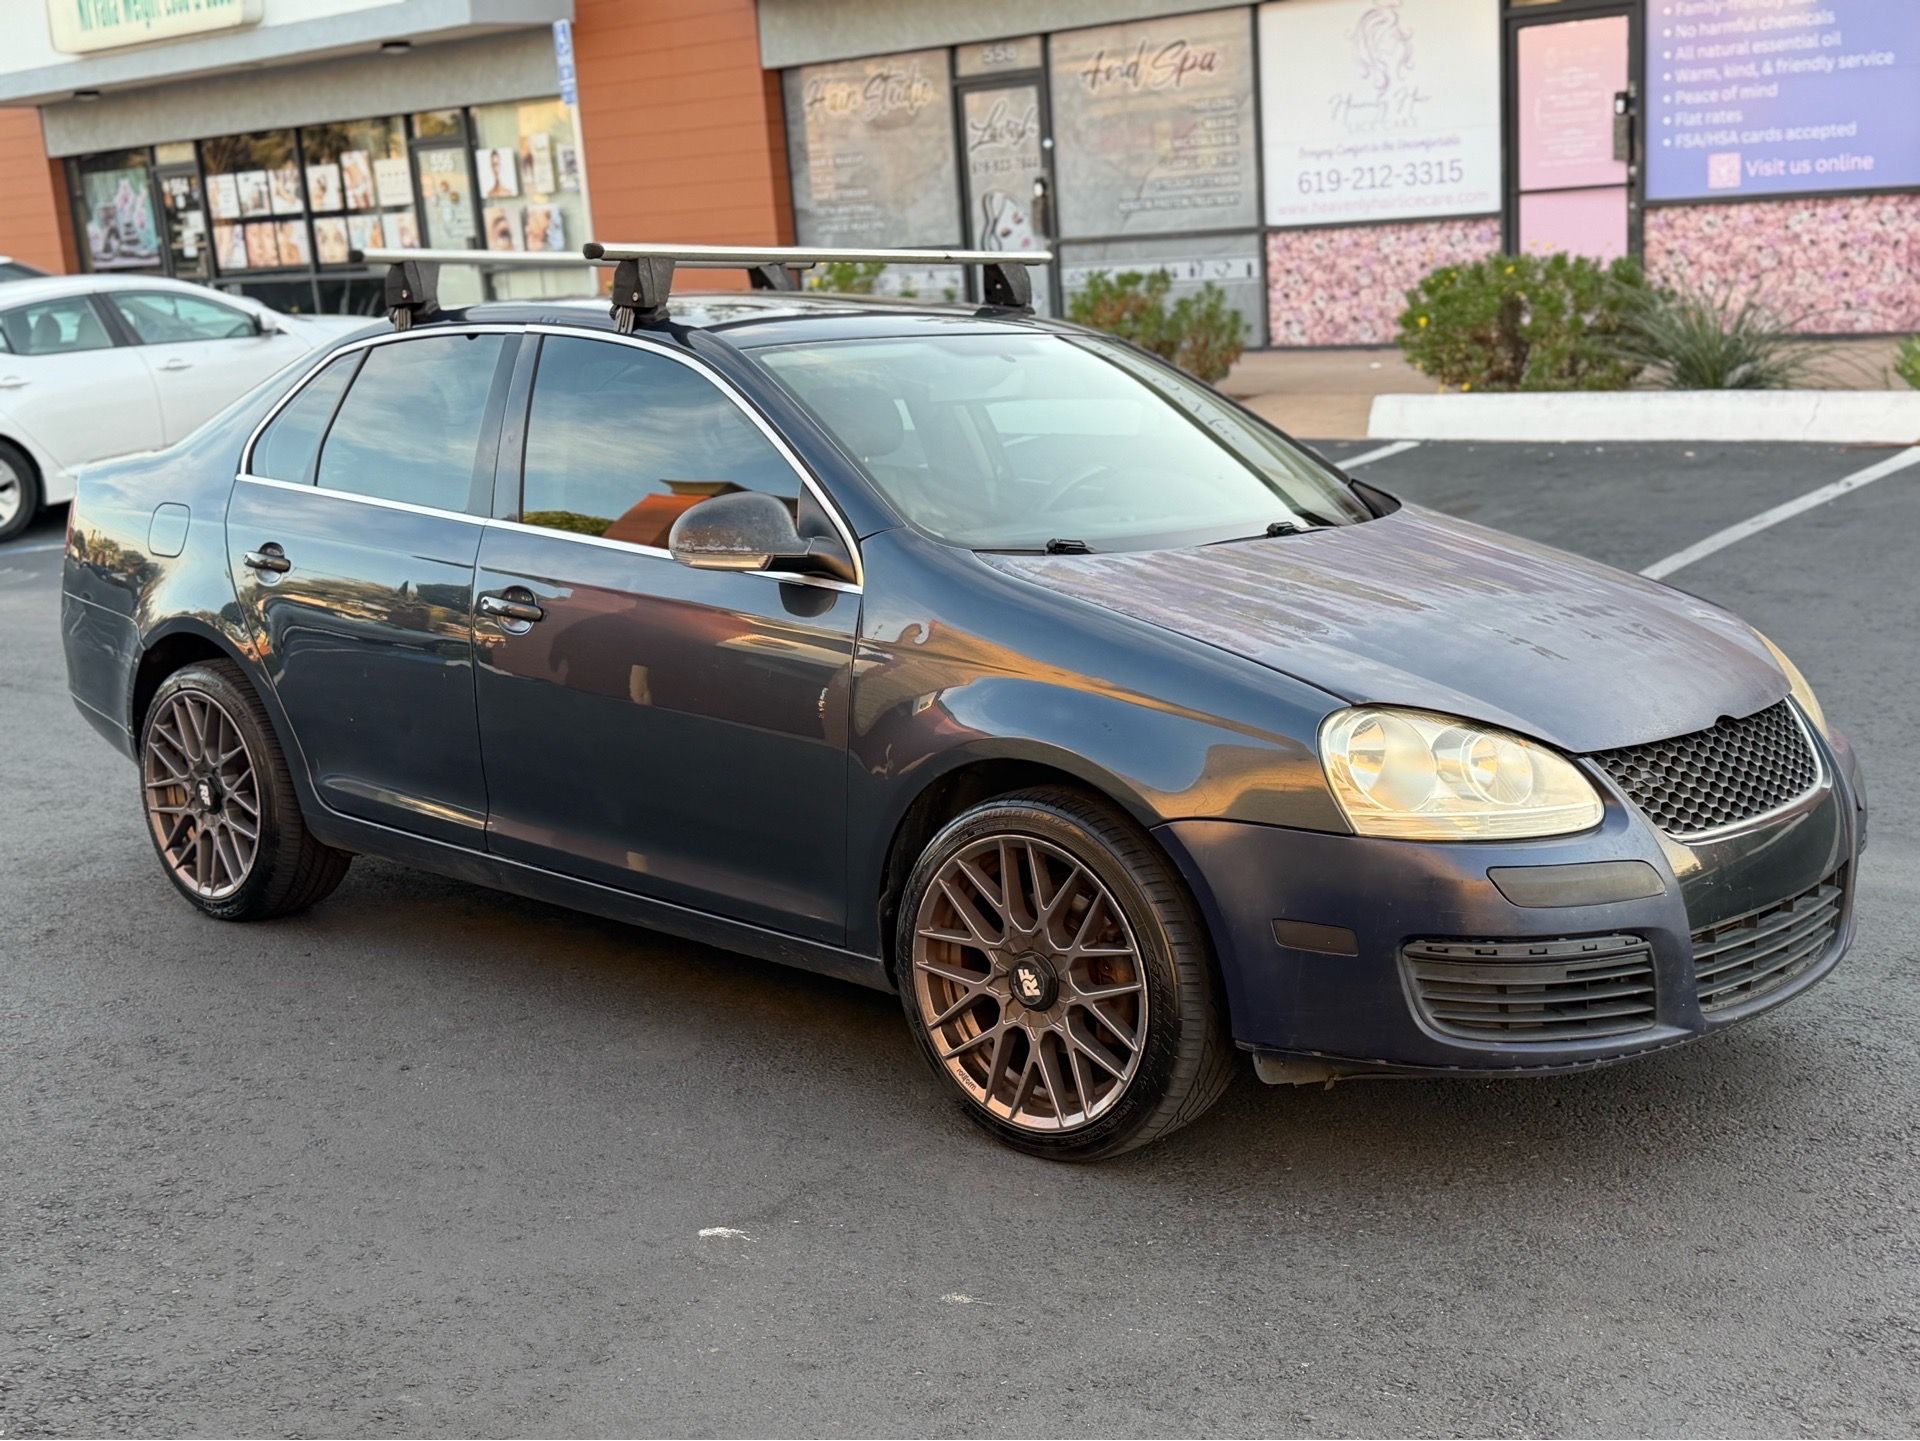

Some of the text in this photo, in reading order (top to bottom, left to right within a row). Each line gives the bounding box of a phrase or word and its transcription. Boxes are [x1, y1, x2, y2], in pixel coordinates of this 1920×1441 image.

[1675, 10, 1836, 39] No harmful chemicals
[1675, 31, 1842, 60] All natural essential oil
[1151, 38, 1218, 89] Spa
[1723, 62, 1760, 78] kind,
[1761, 60, 1774, 75] &
[1775, 55, 1835, 74] friendly
[1837, 50, 1896, 69] service
[1675, 82, 1779, 105] Peace of mind
[1675, 109, 1743, 127] Flat rates
[1675, 121, 1858, 148] FSA/HSA cards accepted
[1298, 159, 1464, 195] 619-212-3315
[1745, 152, 1875, 177] Visit us online
[1017, 968, 1041, 996] RF
